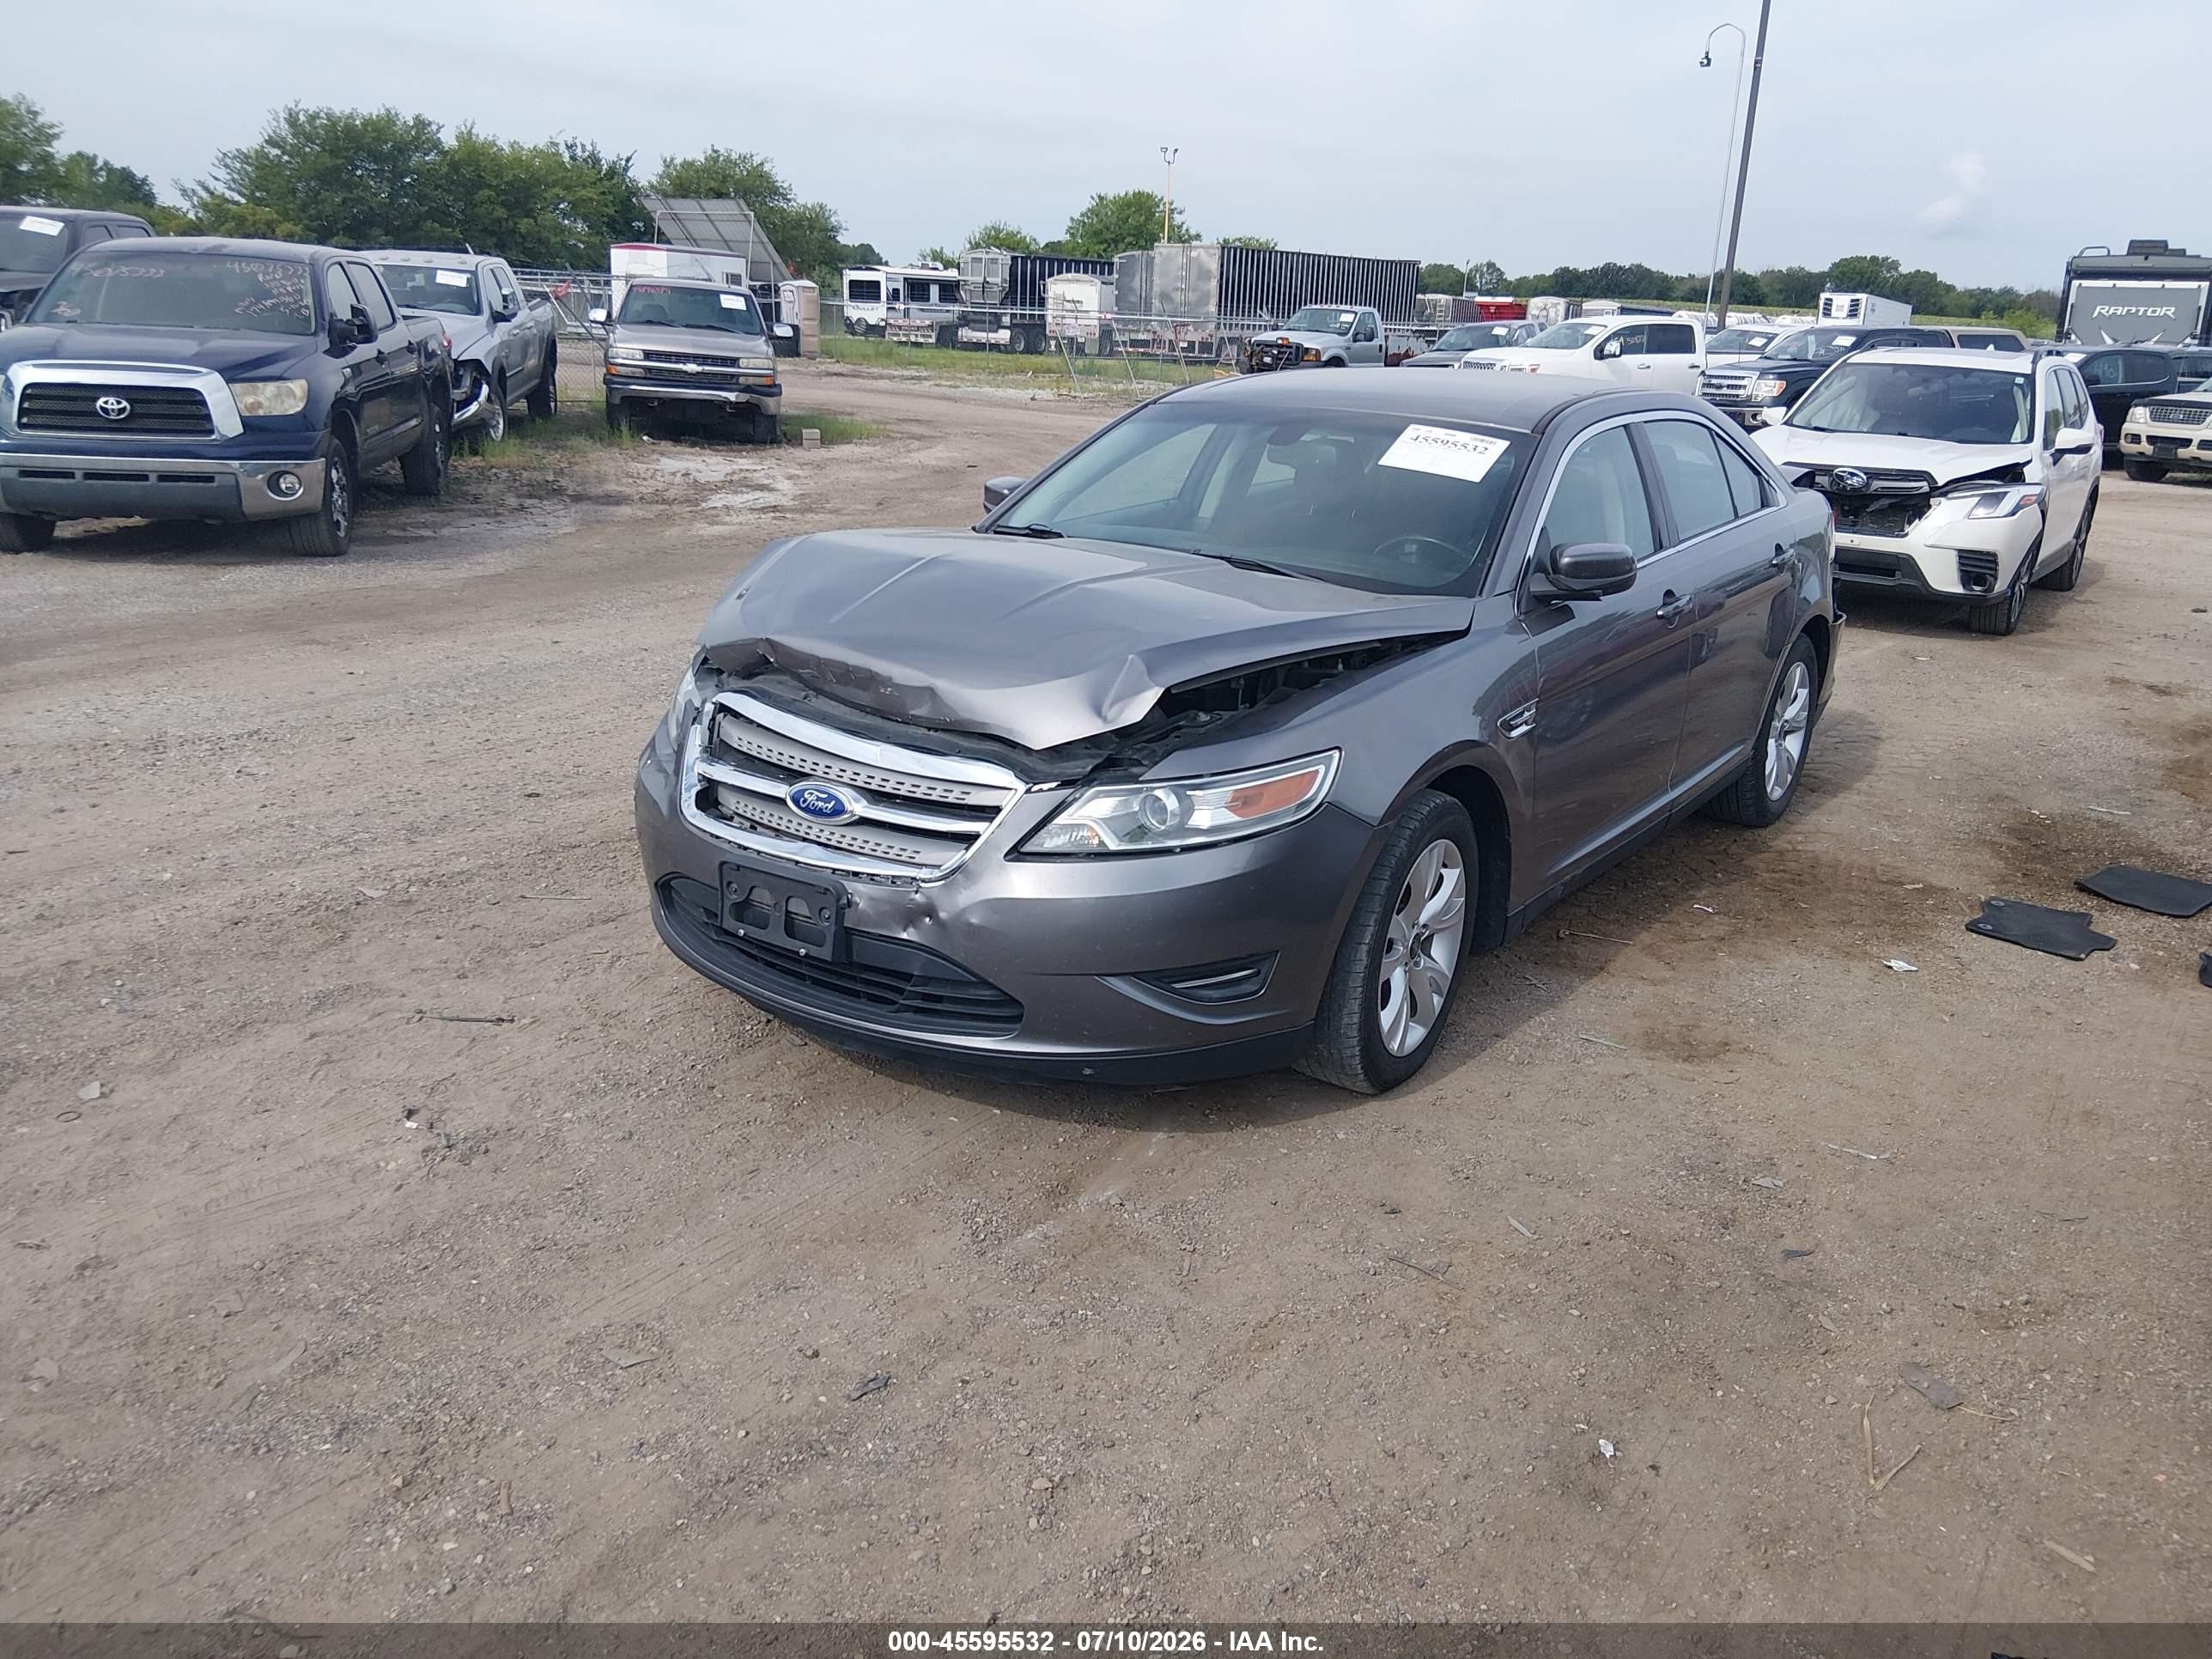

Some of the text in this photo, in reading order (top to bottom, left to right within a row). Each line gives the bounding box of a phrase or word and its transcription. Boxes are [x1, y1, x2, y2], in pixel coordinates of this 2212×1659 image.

[2091, 305, 2177, 320] RAPTOR
[1409, 434, 1489, 454] 45595532
[799, 789, 836, 814] Ford
